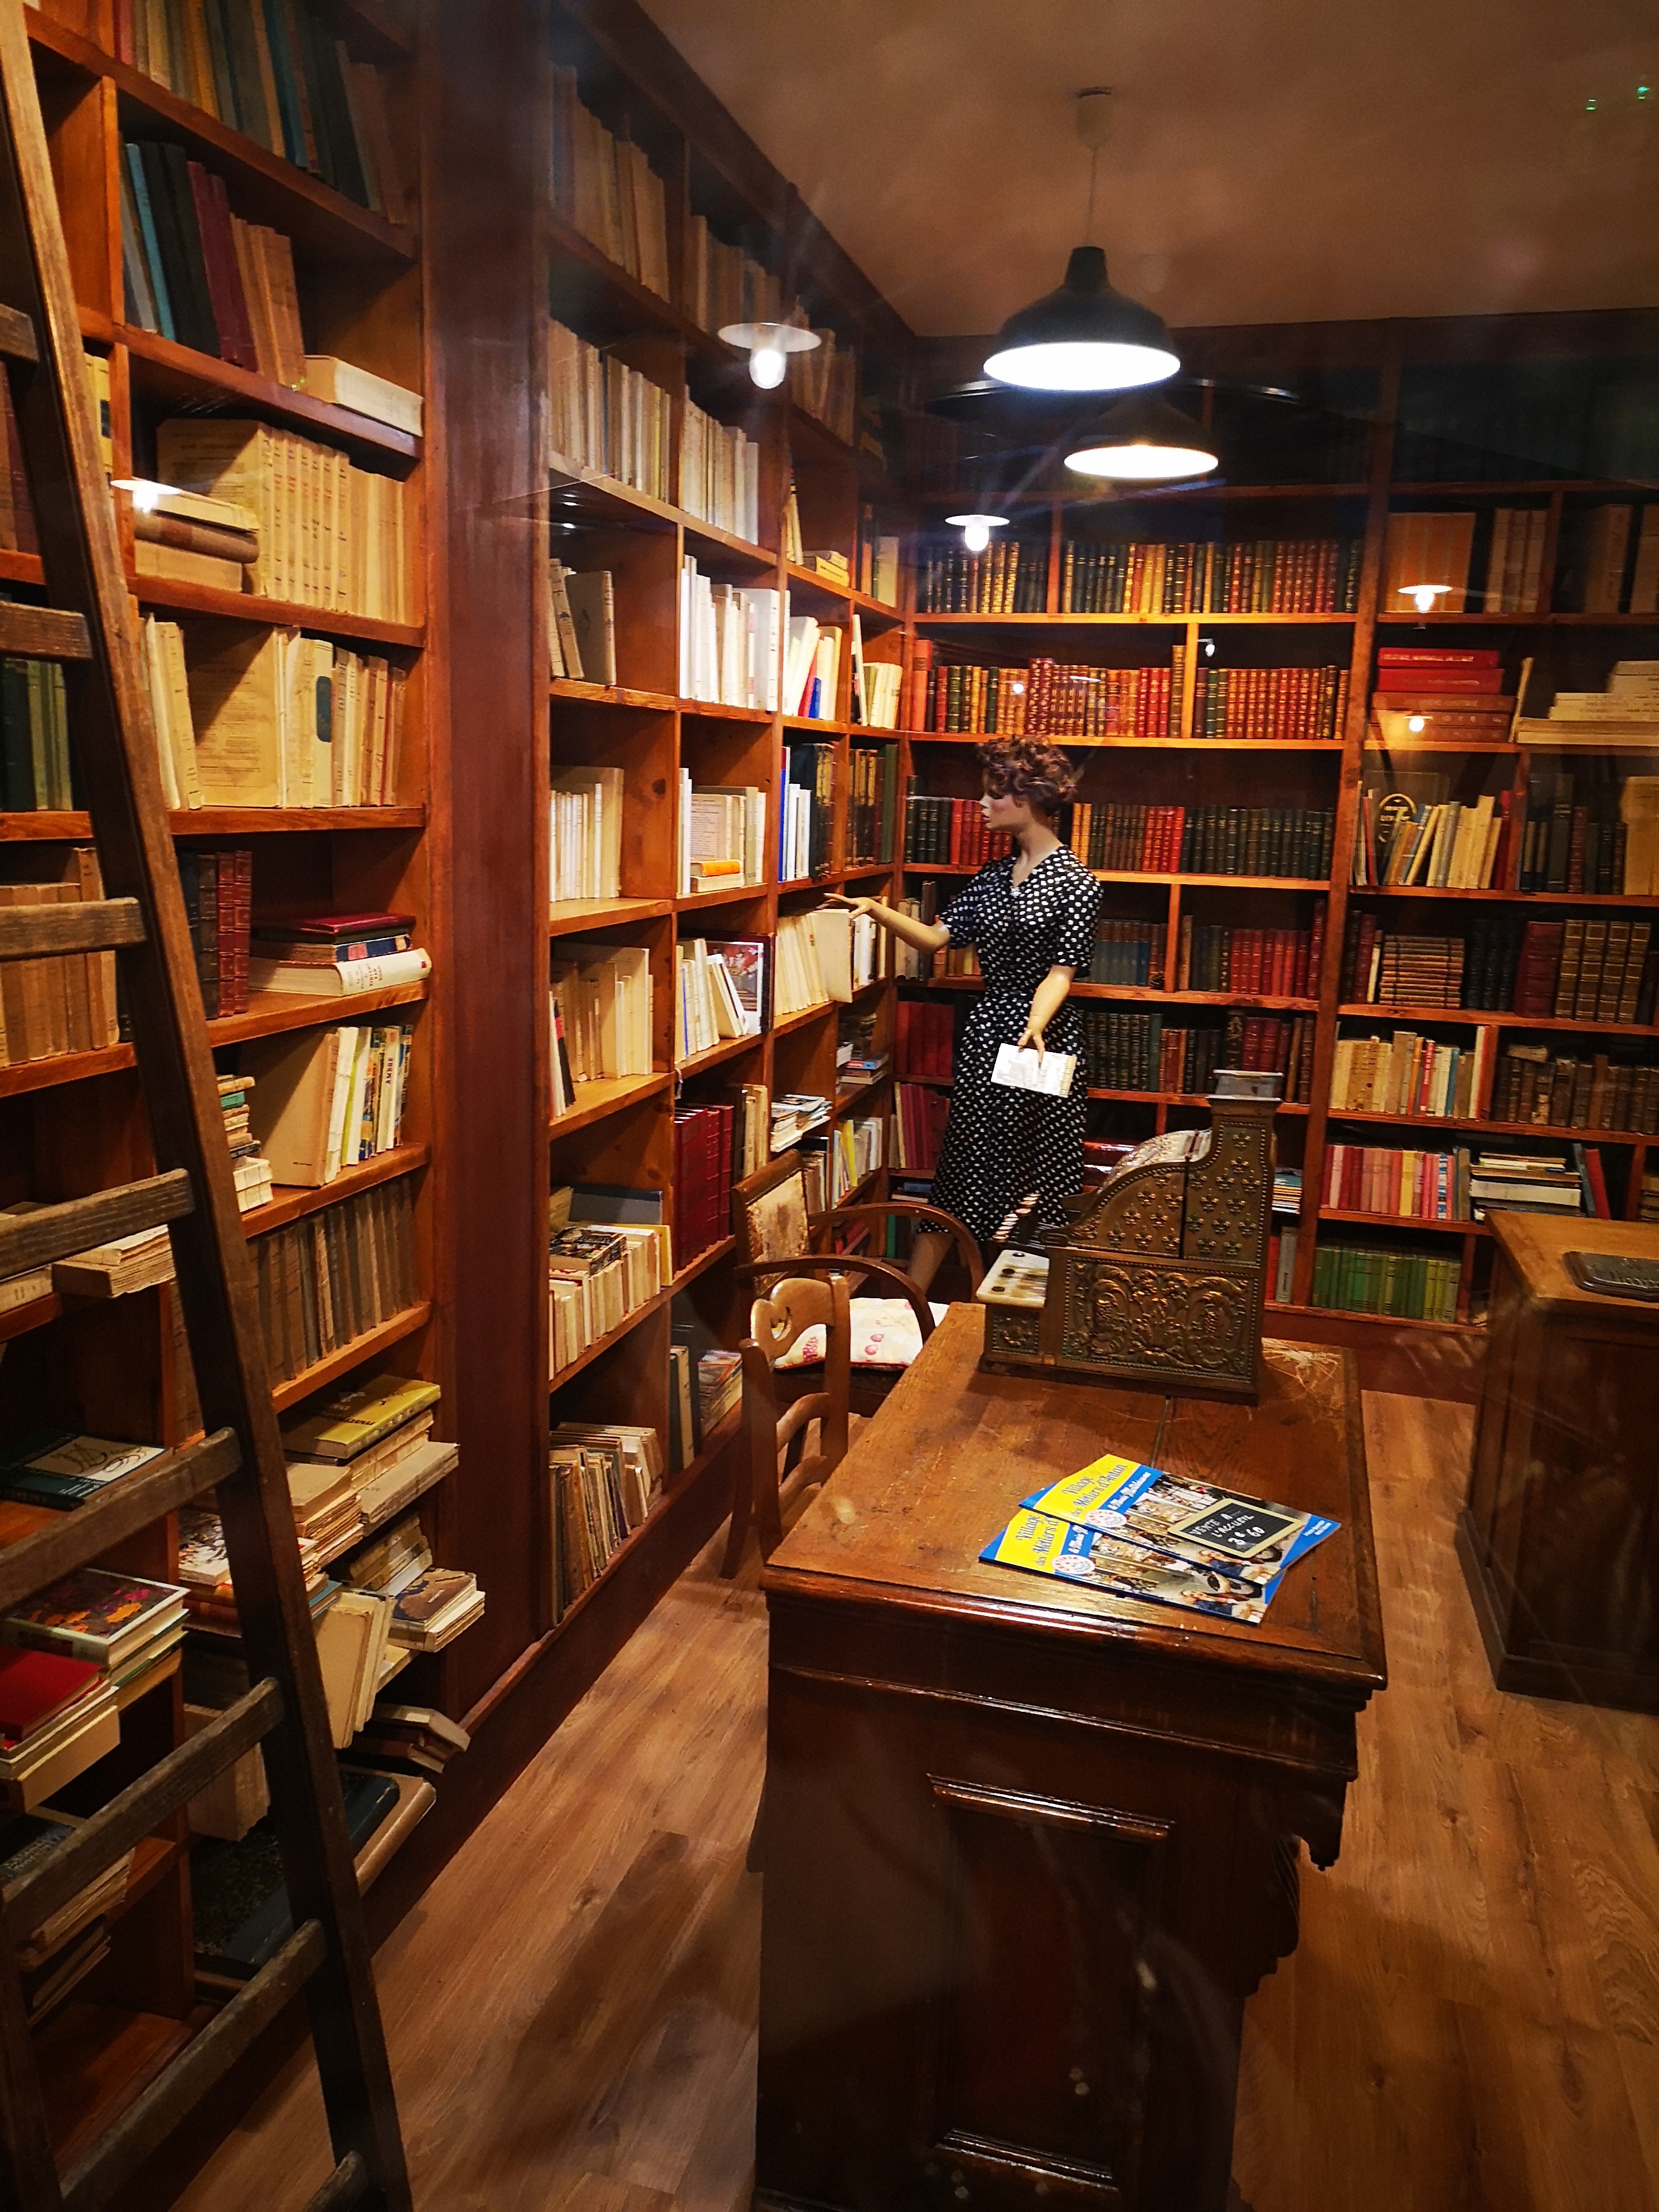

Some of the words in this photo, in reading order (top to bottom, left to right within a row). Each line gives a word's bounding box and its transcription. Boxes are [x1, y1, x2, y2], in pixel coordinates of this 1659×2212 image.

[1062, 1476, 1094, 1495] Village
[1016, 1515, 1045, 1541] Village
[1188, 1518, 1220, 1536] VENTE
[1211, 1515, 1255, 1538] L'ACCUEIL
